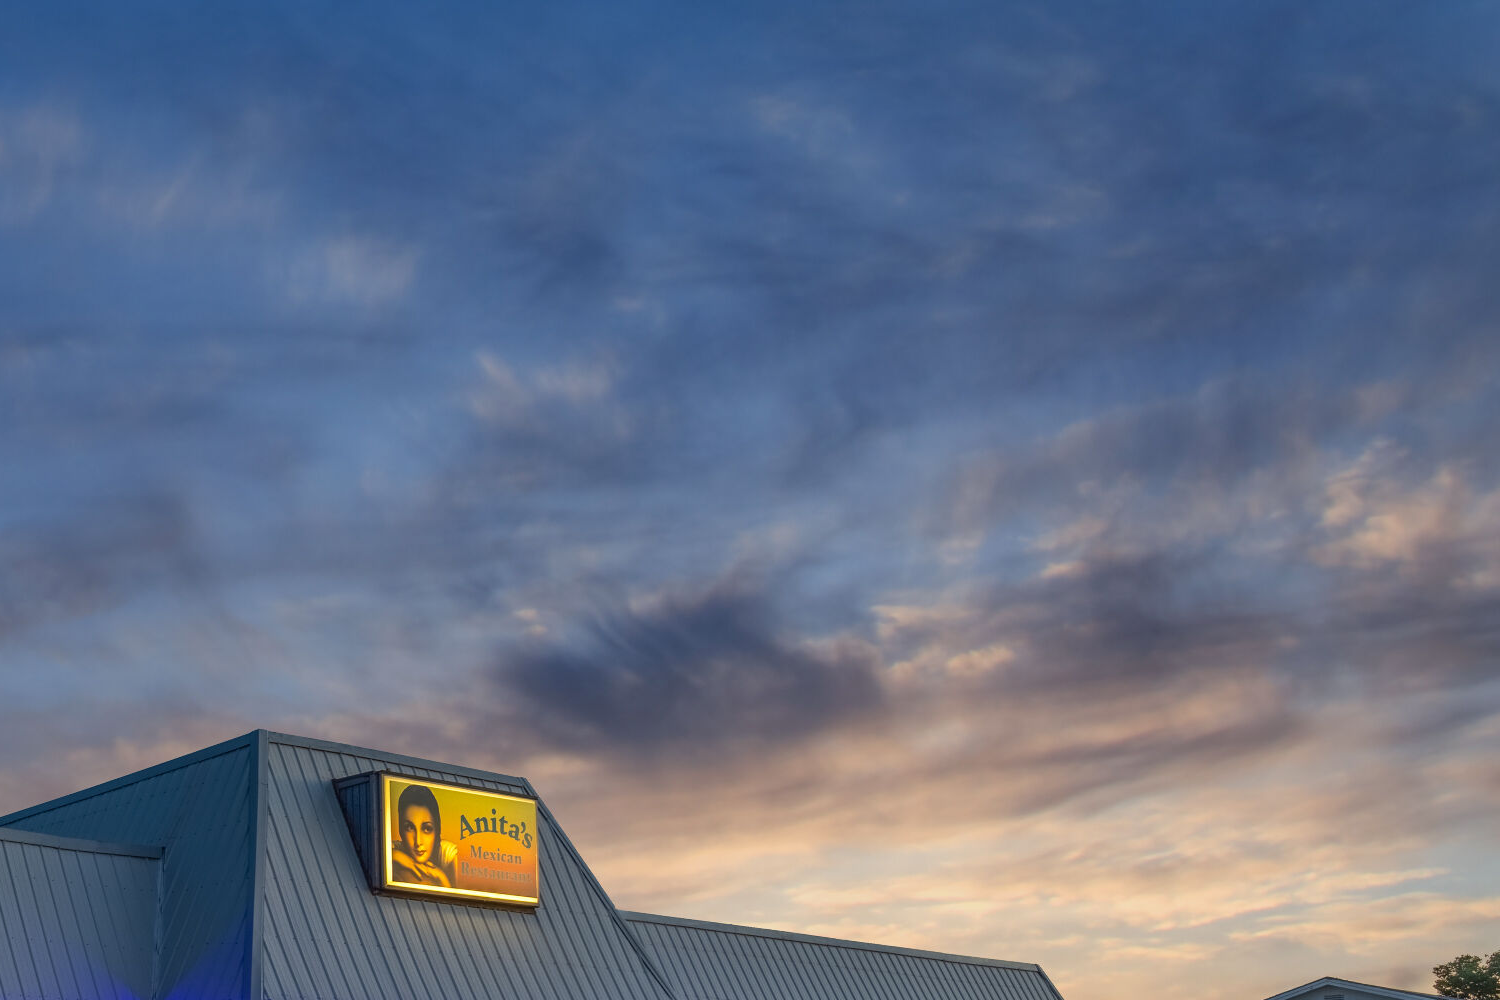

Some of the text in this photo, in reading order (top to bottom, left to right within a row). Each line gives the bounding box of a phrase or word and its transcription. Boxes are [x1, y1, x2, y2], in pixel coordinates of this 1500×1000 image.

[460, 808, 533, 849] Anita's
[470, 845, 522, 865] Mexican
[461, 861, 532, 882] Restaurant
